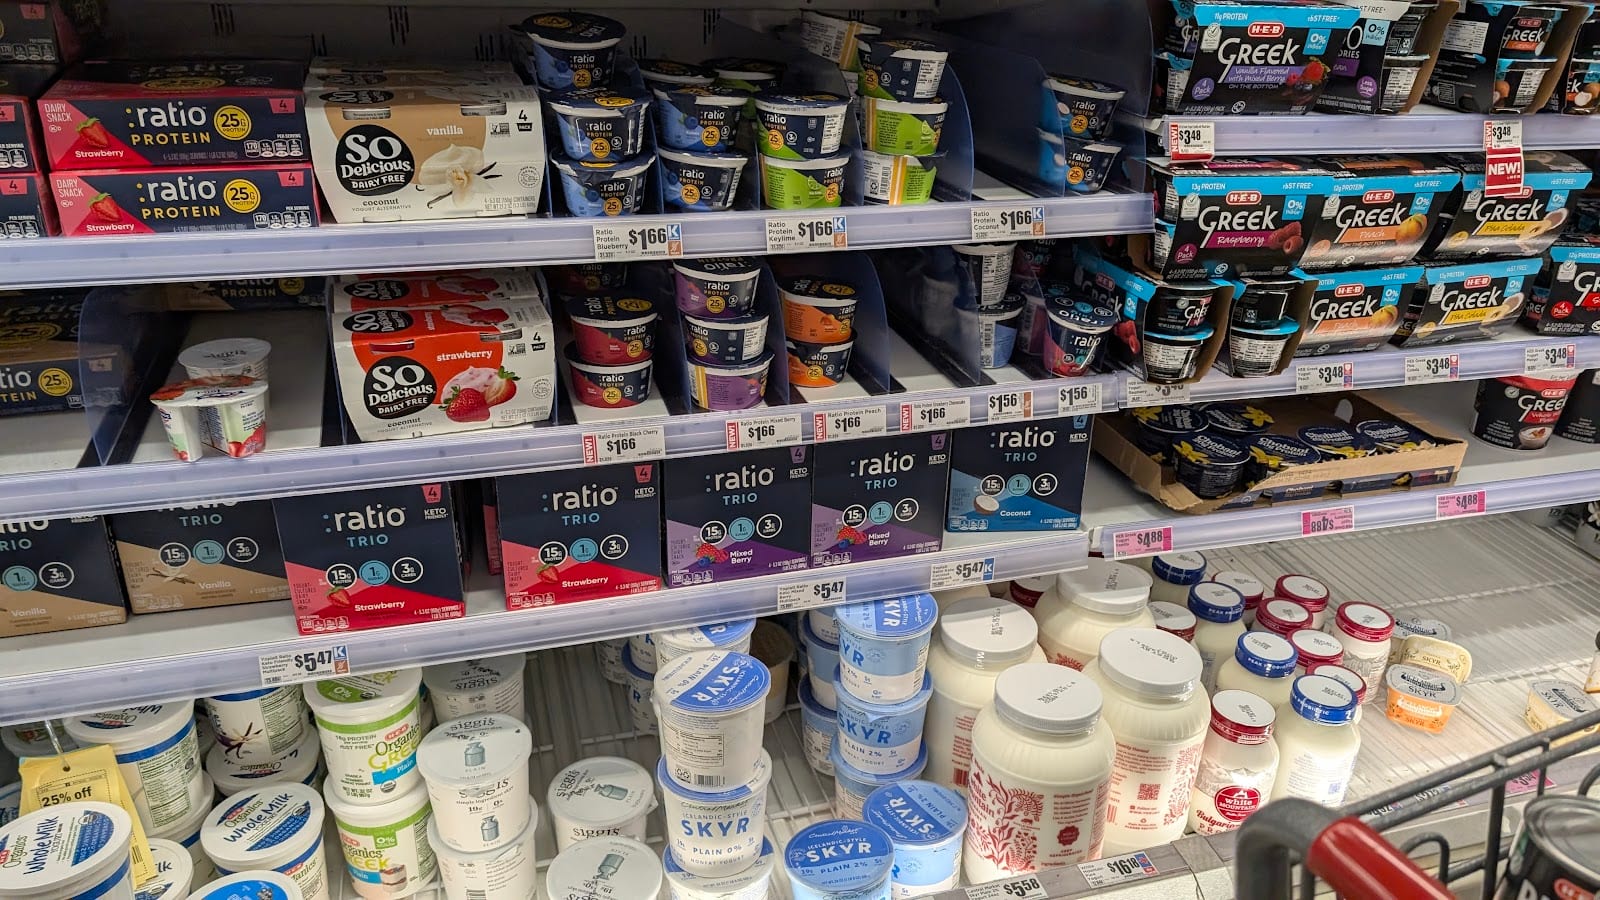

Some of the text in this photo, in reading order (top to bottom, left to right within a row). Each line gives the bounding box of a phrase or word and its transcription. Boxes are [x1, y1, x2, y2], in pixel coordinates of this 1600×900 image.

[1251, 26, 1281, 34] H-E-B
[1310, 34, 1326, 44] 0%
[1217, 37, 1301, 84] GREEK
[1259, 67, 1290, 75] Flavored
[1244, 74, 1265, 82] Mixed
[1266, 73, 1286, 84] Berry
[1193, 87, 1211, 96] Pack
[45, 103, 66, 113] DAIRY
[47, 113, 72, 122] SNACK
[518, 110, 528, 121] 4
[427, 126, 463, 136] vanilla
[1179, 129, 1201, 144] $348
[1493, 126, 1511, 140] $348
[131, 132, 211, 145] PROTEIN
[1170, 124, 1178, 153] NEW!
[75, 150, 124, 159] Strawberry
[345, 134, 402, 163] SO
[1488, 162, 1521, 175] NEW!
[56, 179, 78, 190] DAIRY
[352, 174, 405, 189] DAIRY FREE
[59, 187, 84, 198] SNACK
[1229, 194, 1259, 202] H-E-B
[362, 198, 399, 206] coconut
[1287, 200, 1303, 210] 0%
[1415, 197, 1429, 205] 0%
[142, 206, 220, 220] PROTEIN
[1000, 210, 1032, 230] $166
[1471, 199, 1544, 236] GREEK
[87, 223, 135, 232] Strawberry
[1200, 205, 1279, 248] GREEK
[1334, 202, 1407, 243] GREEK
[798, 220, 833, 242] $166
[628, 228, 667, 250] $166
[769, 235, 796, 243] Keylime
[1217, 236, 1265, 246] Raspberry
[1177, 251, 1194, 260] Pack
[1310, 295, 1378, 334] GREEK
[532, 331, 541, 342] 4
[436, 349, 493, 362] strawberry
[1545, 348, 1567, 363] $348
[1426, 358, 1449, 374] $348
[371, 364, 425, 392] SO
[1319, 366, 1343, 383] $348
[989, 393, 1017, 412] $156
[1060, 386, 1088, 406] $156
[378, 397, 428, 414] DAIRY FREE
[387, 417, 421, 428] coconut
[902, 406, 911, 430] NEW!
[920, 408, 946, 423] $166
[816, 416, 825, 440] NEW!
[834, 417, 861, 432] $166
[727, 422, 738, 449] NEW!
[748, 425, 775, 441] $166
[584, 436, 595, 463] NEW!
[607, 438, 636, 454] $166
[794, 448, 803, 459] 4
[928, 454, 946, 462] KETO
[1004, 452, 1038, 462] TRIO
[640, 467, 647, 477] 4
[790, 467, 808, 476] KETO
[634, 487, 654, 495] KETO
[865, 478, 898, 490] TRIO
[429, 487, 436, 497] 4
[722, 492, 758, 505] TRIO
[1456, 493, 1479, 510] $488
[178, 514, 223, 527] TRIO
[562, 512, 600, 526] TRIO
[347, 534, 389, 548] TRIO
[868, 531, 890, 540] Mixed
[869, 537, 889, 546] Berry
[1137, 529, 1164, 548] $488
[729, 549, 753, 558] Mixed
[731, 556, 752, 565] Berry
[956, 562, 983, 578] $547
[199, 580, 232, 589] Vanilla
[562, 577, 608, 588] Strawberry
[814, 581, 844, 599] $547
[11, 607, 47, 617] Vanilla
[354, 601, 405, 612] Strawberry
[294, 650, 332, 672] $547
[695, 666, 740, 703] SKYR
[839, 711, 892, 744] SKYR
[844, 739, 866, 754] PLAIN
[397, 759, 414, 773] Plain
[42, 786, 92, 807] 25% off
[1219, 802, 1257, 810] MOUNTAIN
[224, 814, 267, 842] Whole
[262, 793, 293, 814] Milk
[225, 799, 263, 828] Organics
[681, 817, 750, 838] SKYR
[23, 816, 59, 875] Whole Milk
[693, 844, 742, 856] PLAIN 0%
[807, 837, 867, 850] ICELANDIC-STYLE
[3, 835, 28, 868] Organics
[806, 842, 872, 863] SKYR
[820, 864, 850, 874] PLAIN
[1107, 858, 1140, 876] $1618
[1003, 878, 1040, 897] $558
